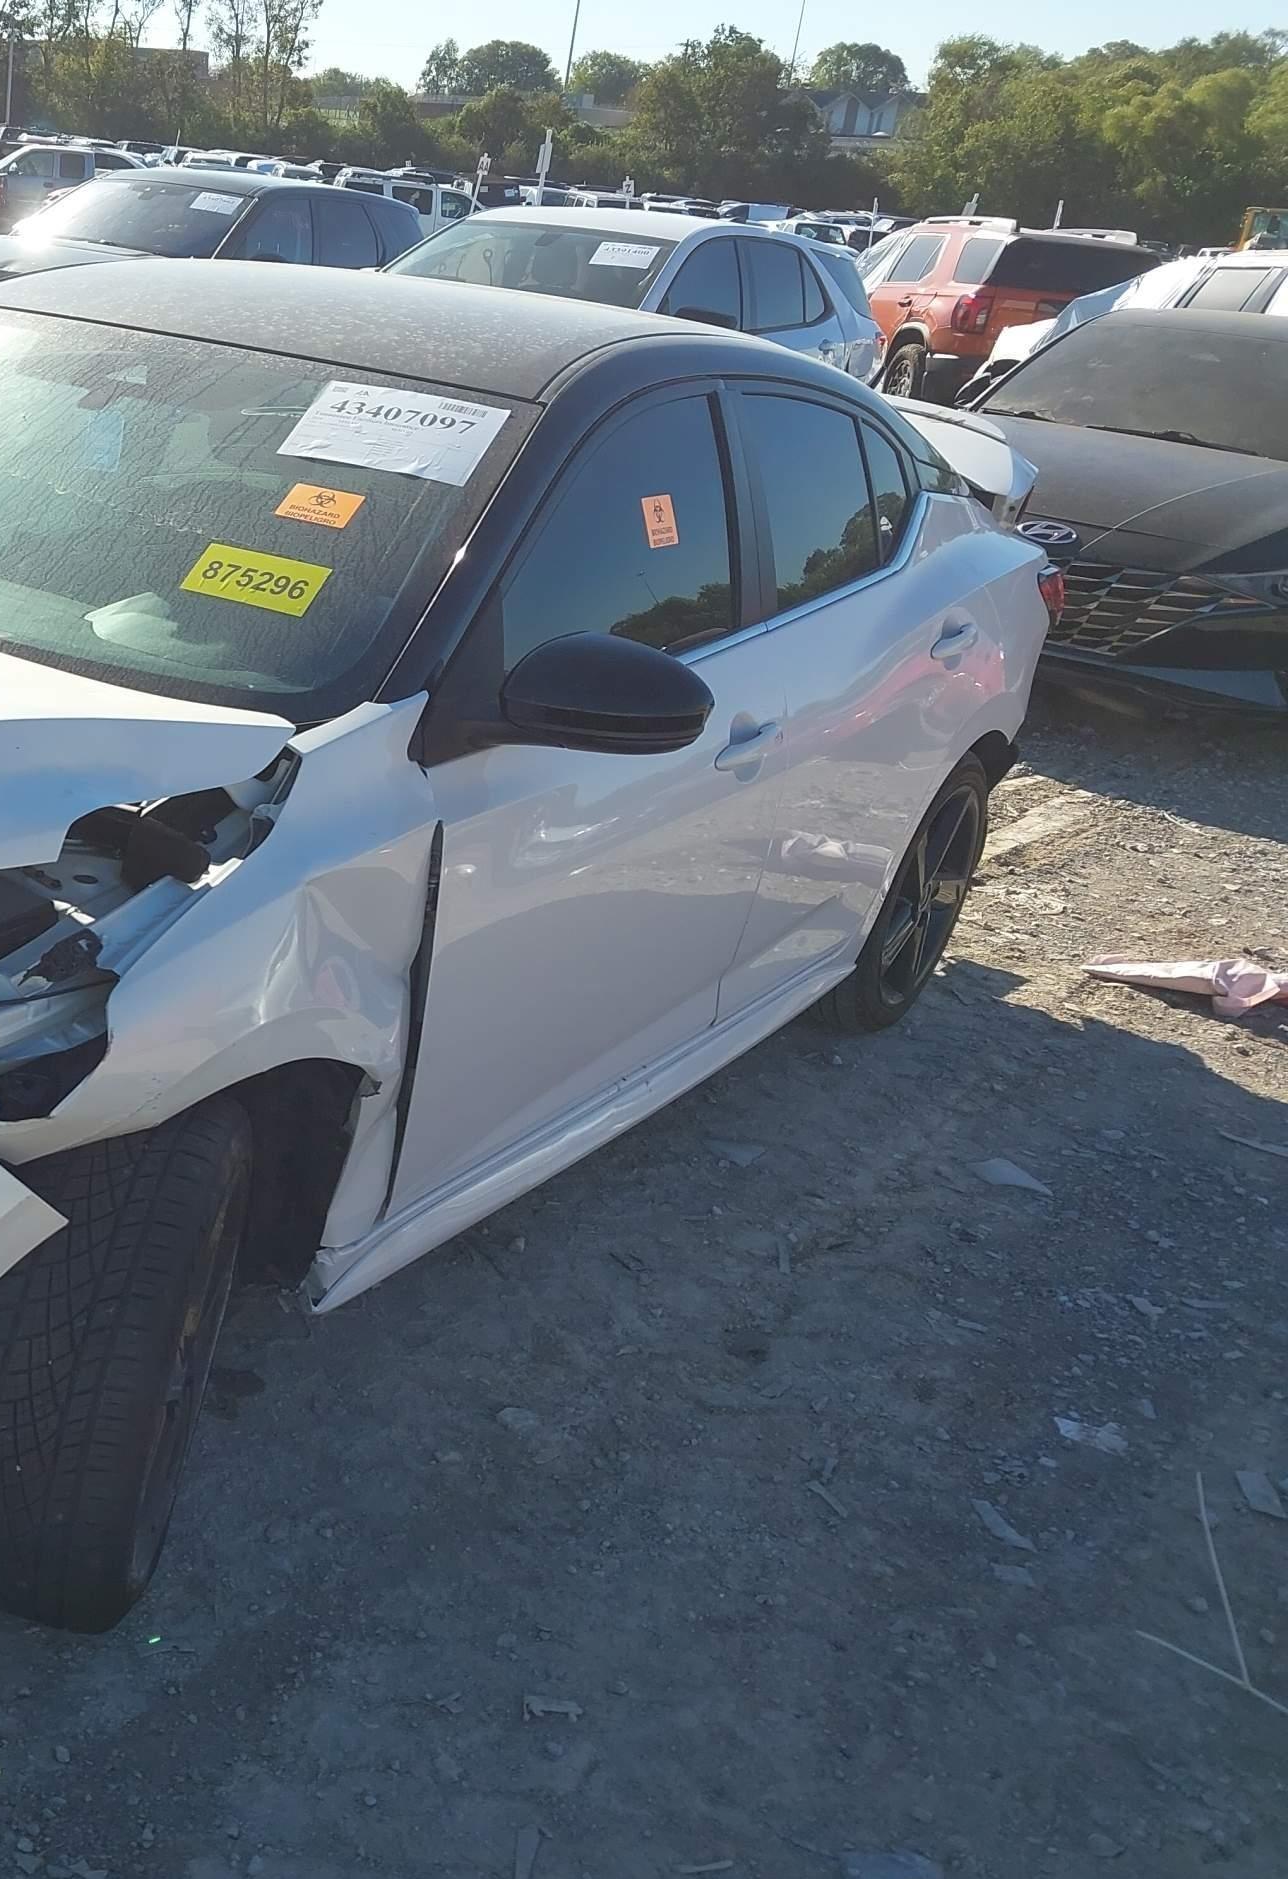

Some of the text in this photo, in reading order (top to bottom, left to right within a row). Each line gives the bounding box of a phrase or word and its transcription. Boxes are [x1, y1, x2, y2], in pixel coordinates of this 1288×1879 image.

[330, 399, 479, 435] 43407097
[284, 511, 337, 525] BIOPELIGRO
[288, 504, 341, 519] BIOHAZARD
[201, 560, 310, 600] 875296
